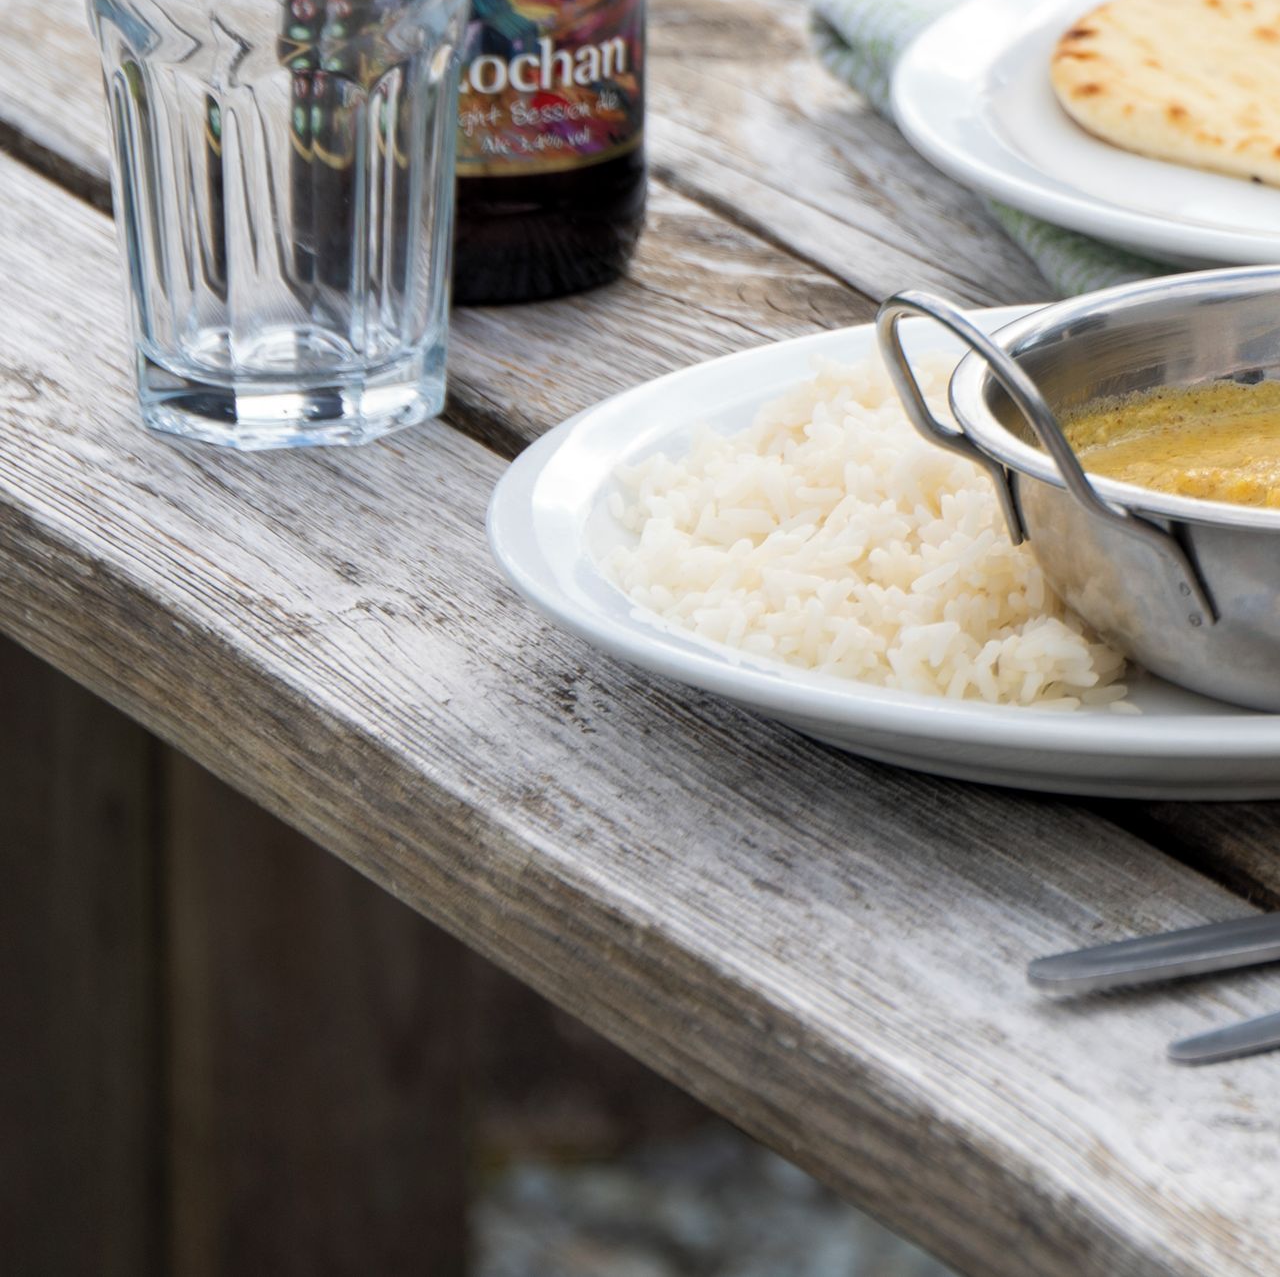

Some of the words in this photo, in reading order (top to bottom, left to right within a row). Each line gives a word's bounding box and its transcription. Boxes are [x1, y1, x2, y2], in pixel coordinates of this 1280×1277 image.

[457, 36, 627, 95] ochan
[458, 103, 502, 137] ght
[510, 101, 592, 126] Session
